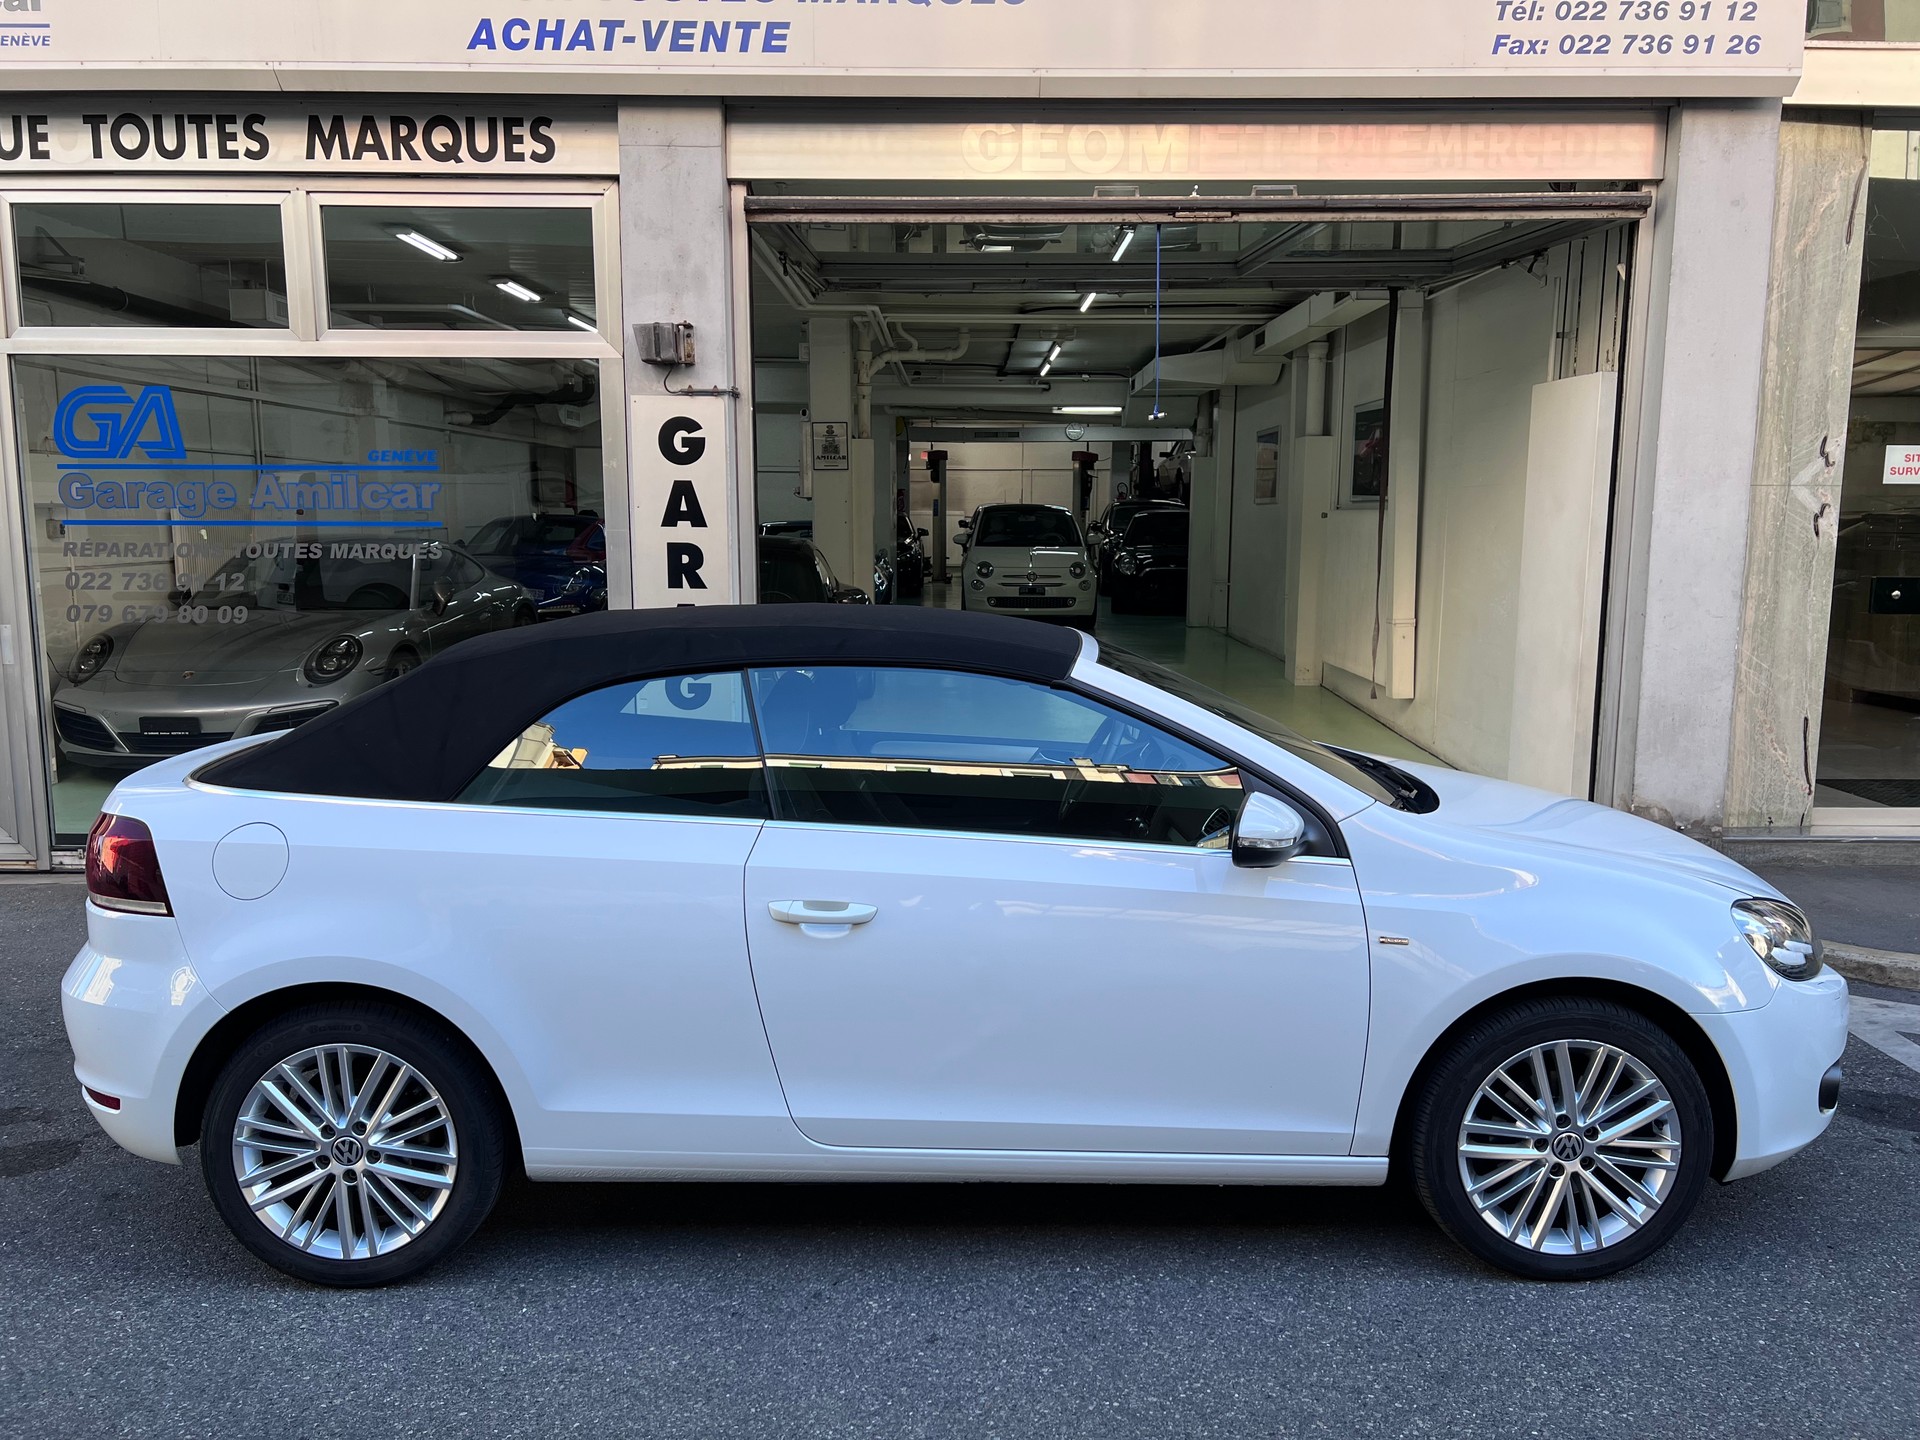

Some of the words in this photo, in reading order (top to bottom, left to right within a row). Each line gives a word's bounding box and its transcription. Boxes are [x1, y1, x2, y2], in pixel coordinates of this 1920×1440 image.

[1496, 0, 1545, 21] Tél:
[1555, 0, 1608, 21] 022
[1618, 0, 1670, 21] 736
[1678, 0, 1712, 21] 91
[1727, 0, 1758, 21] 12
[466, 18, 791, 53] ACHAT-VENTE
[1491, 34, 1549, 55] Fax:
[1558, 34, 1611, 55] 022
[1622, 34, 1674, 55] 736
[1682, 34, 1715, 55] 91
[1725, 34, 1762, 55] 26
[82, 112, 270, 161] TOUTES
[305, 114, 557, 164] MARQUES
[58, 472, 237, 518] Garage
[251, 473, 442, 512] Amilcar
[232, 541, 323, 560] TOUTES
[329, 541, 444, 561] MARQUES
[65, 571, 112, 591] 022
[121, 571, 168, 591] 736
[215, 571, 246, 591] 12
[66, 604, 113, 624] 079
[121, 604, 169, 625] 679
[177, 604, 209, 625] 80
[217, 604, 249, 625] 09
